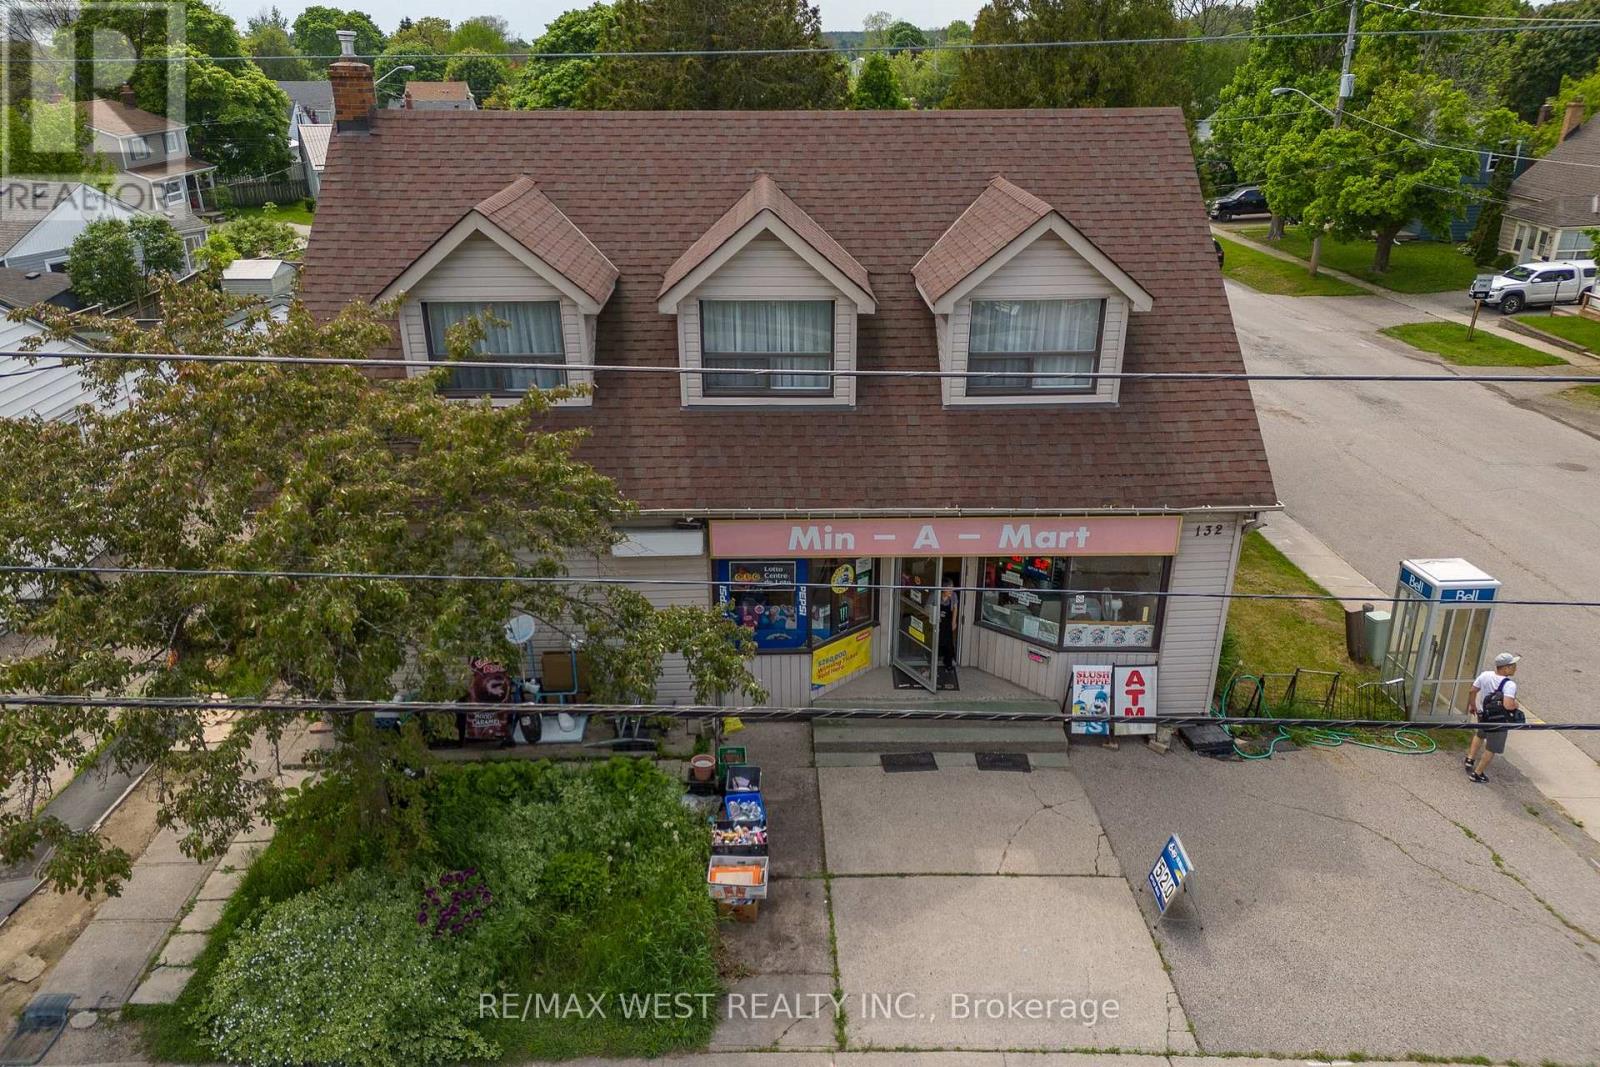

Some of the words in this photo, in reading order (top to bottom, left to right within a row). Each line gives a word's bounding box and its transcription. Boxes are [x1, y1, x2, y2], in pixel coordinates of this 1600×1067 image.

[788, 525, 855, 551] Min
[913, 525, 941, 549] A
[998, 524, 1090, 549] Mart
[1195, 524, 1223, 537] 132
[1409, 574, 1424, 594] Bell
[799, 585, 807, 616] PEPSI
[1456, 589, 1480, 600] Bell
[1076, 671, 1110, 679] SLUSH
[1125, 670, 1146, 717] ATM
